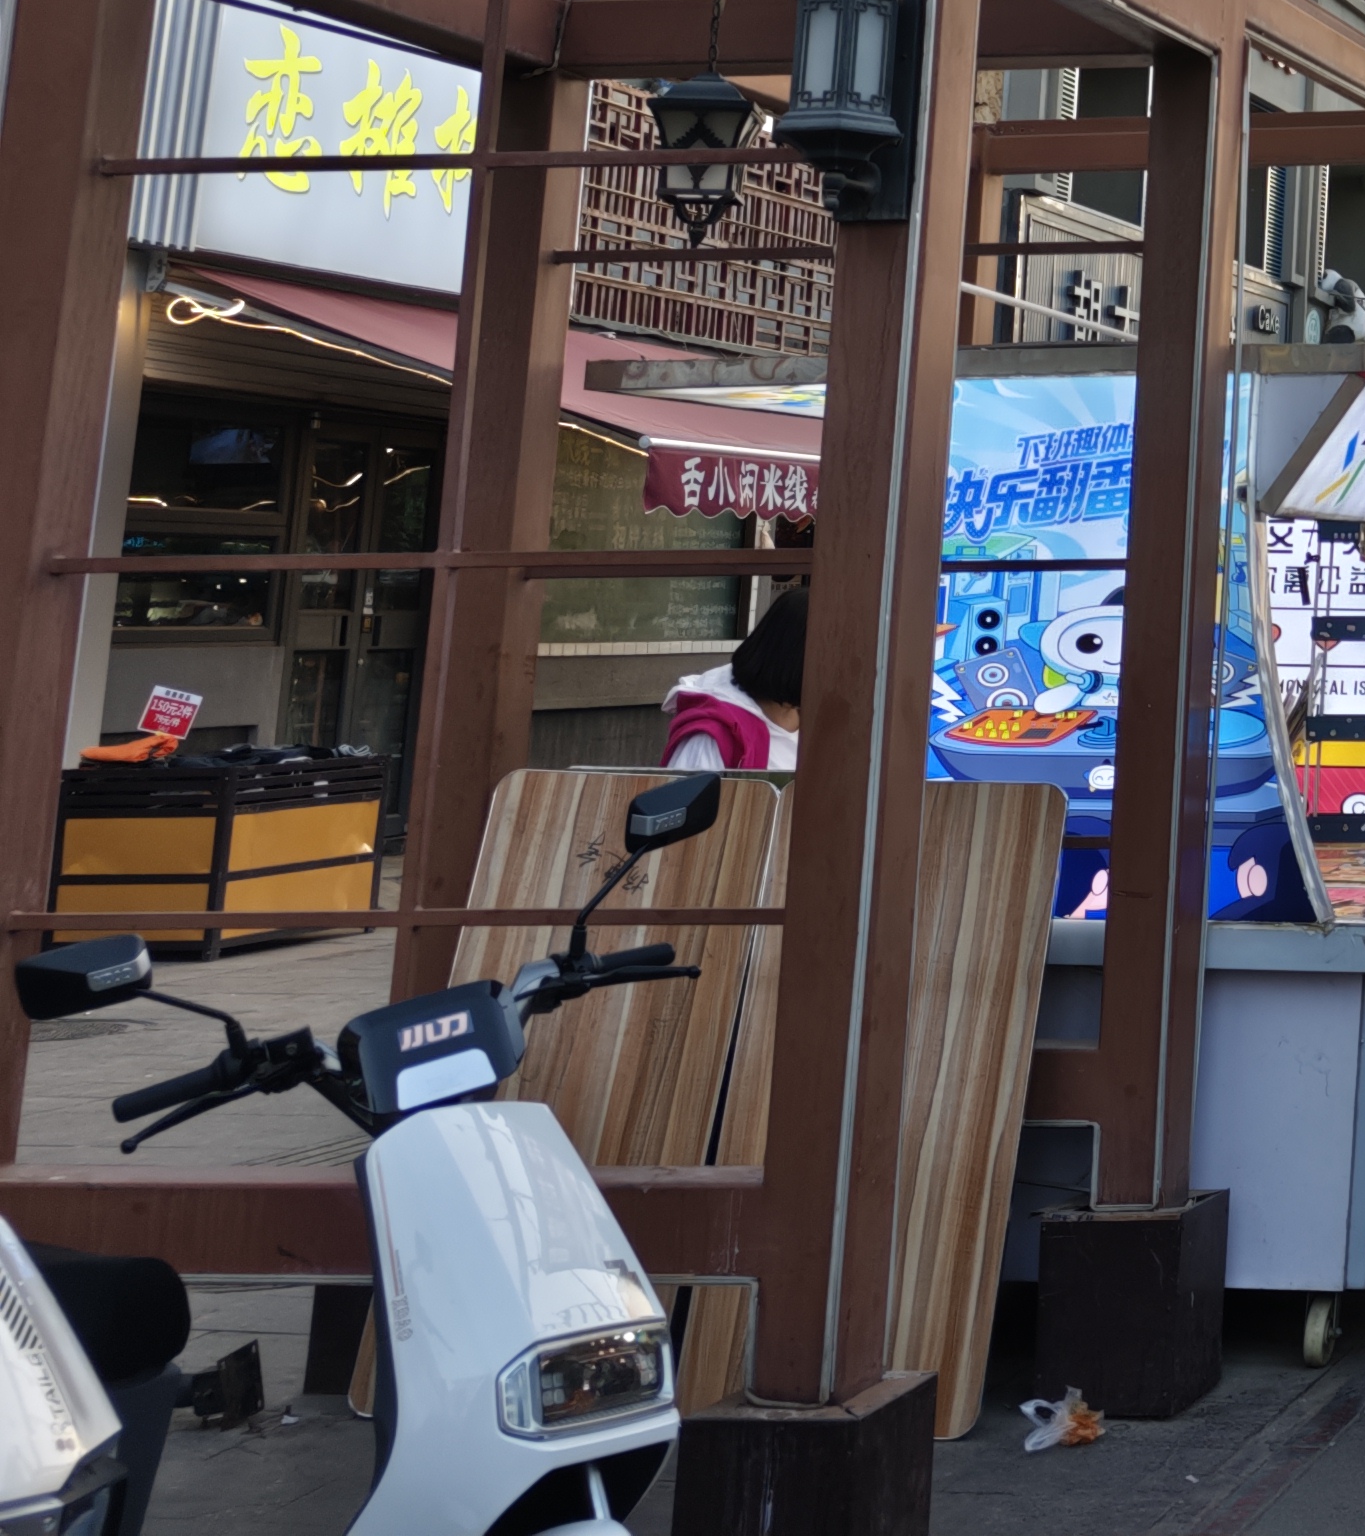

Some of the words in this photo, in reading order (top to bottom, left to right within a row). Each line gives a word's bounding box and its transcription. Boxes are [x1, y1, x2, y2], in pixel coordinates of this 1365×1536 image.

[1257, 304, 1281, 335] Cake
[1017, 422, 1133, 468] 下班趣体
